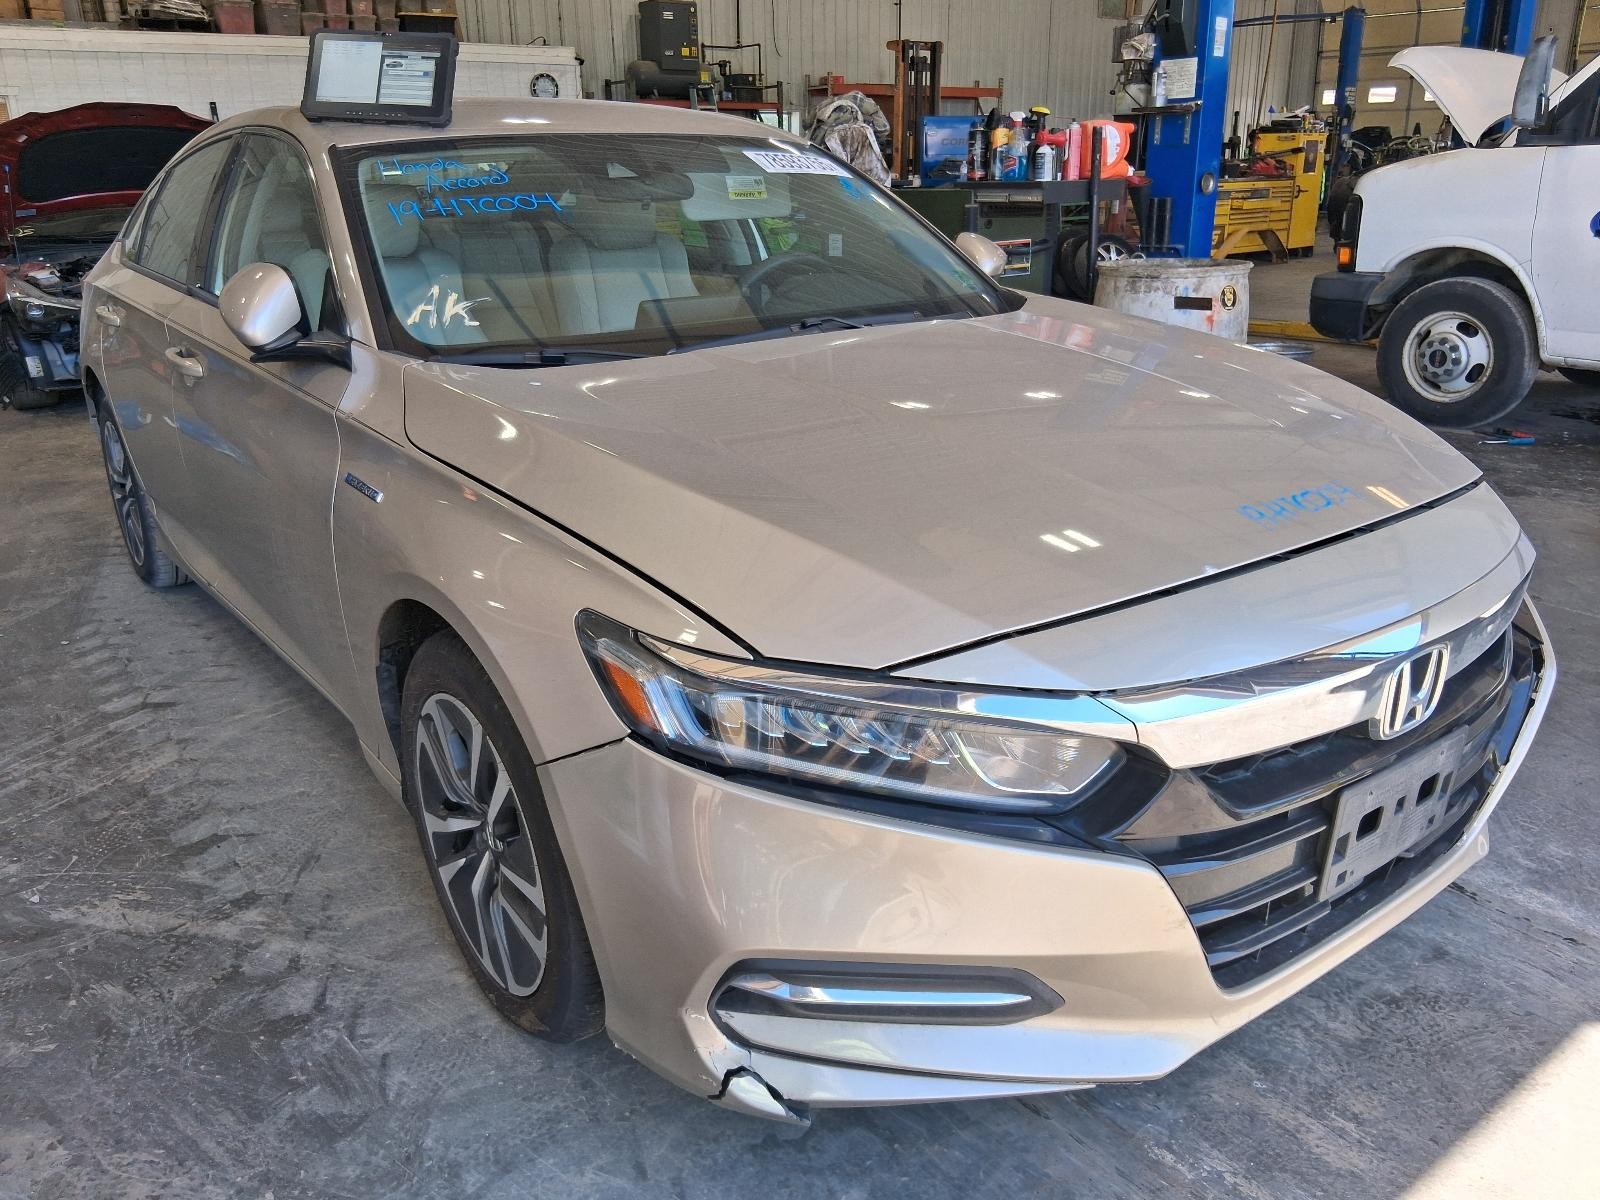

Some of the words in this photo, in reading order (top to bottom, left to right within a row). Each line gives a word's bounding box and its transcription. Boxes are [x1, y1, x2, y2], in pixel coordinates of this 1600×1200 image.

[377, 158, 466, 180] Honda
[425, 167, 510, 193] Accord
[387, 192, 562, 226] 19-HTC004
[406, 284, 492, 329] AK
